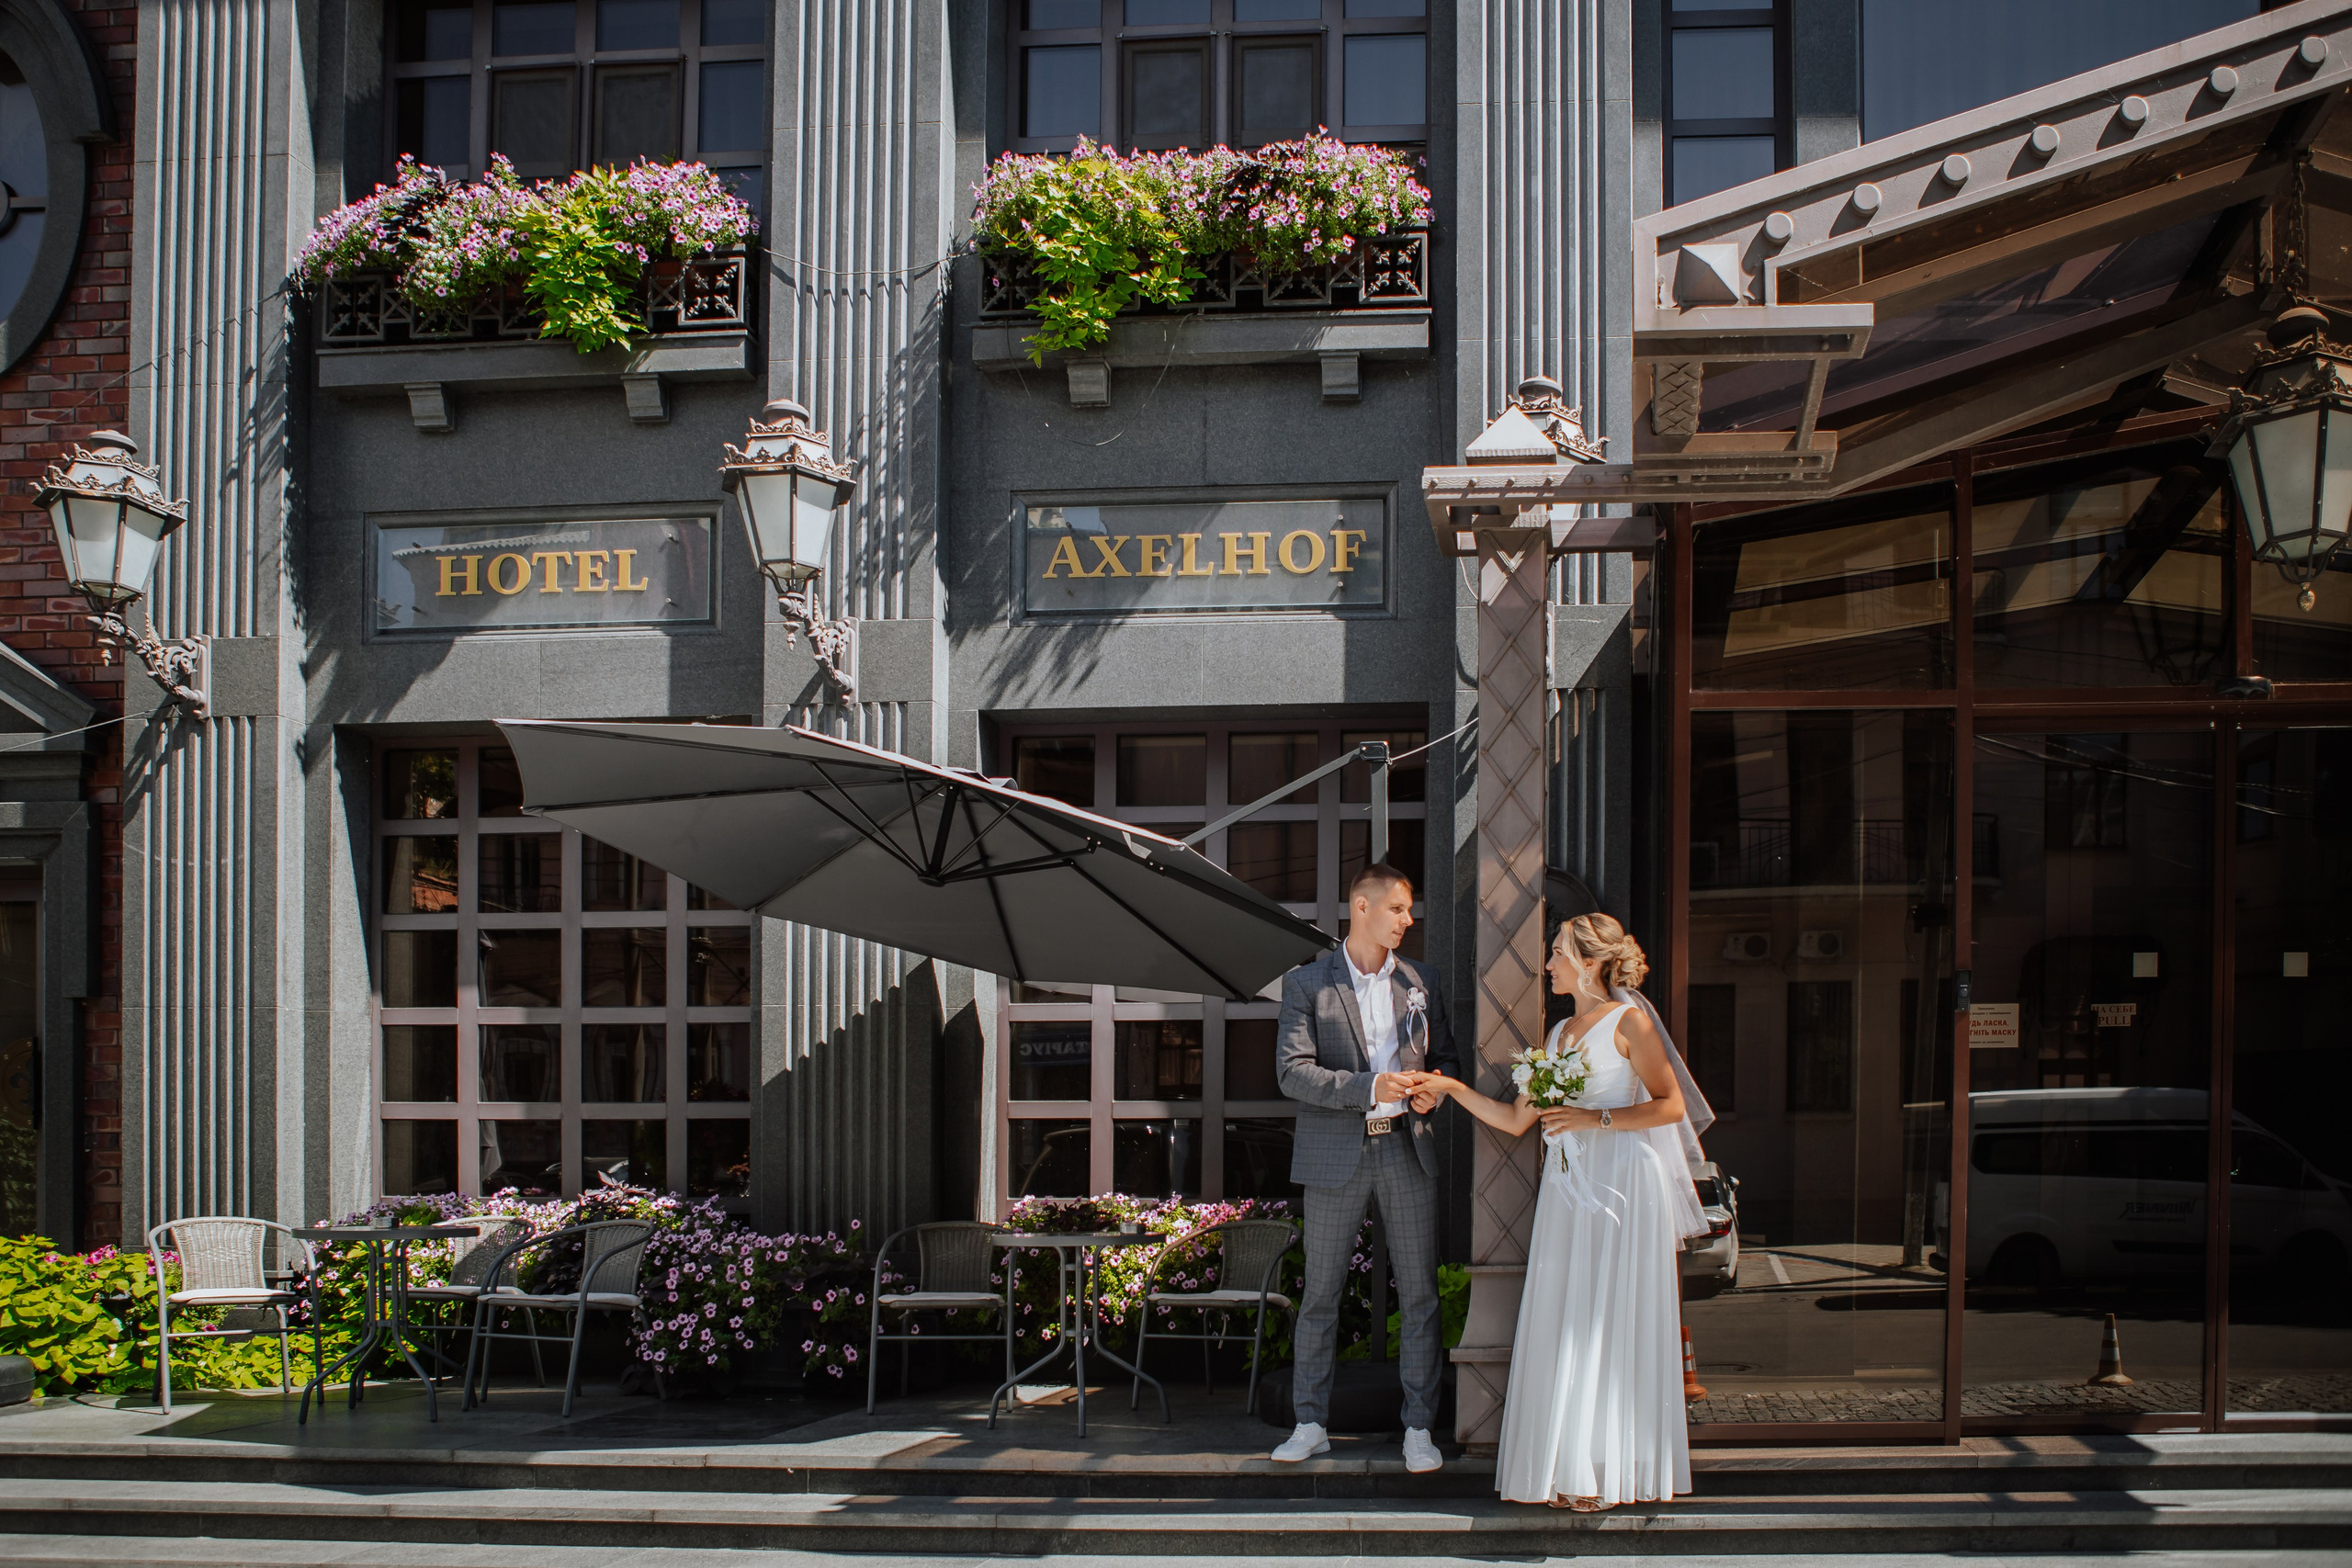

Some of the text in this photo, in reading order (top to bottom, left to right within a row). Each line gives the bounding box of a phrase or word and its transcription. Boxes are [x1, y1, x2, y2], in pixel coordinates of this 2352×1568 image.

[1042, 529, 1367, 579] AXELHOF
[435, 549, 649, 597] HOTEL
[2098, 1015, 2130, 1025] PULL
[2109, 1005, 2135, 1013] СЕБЕ
